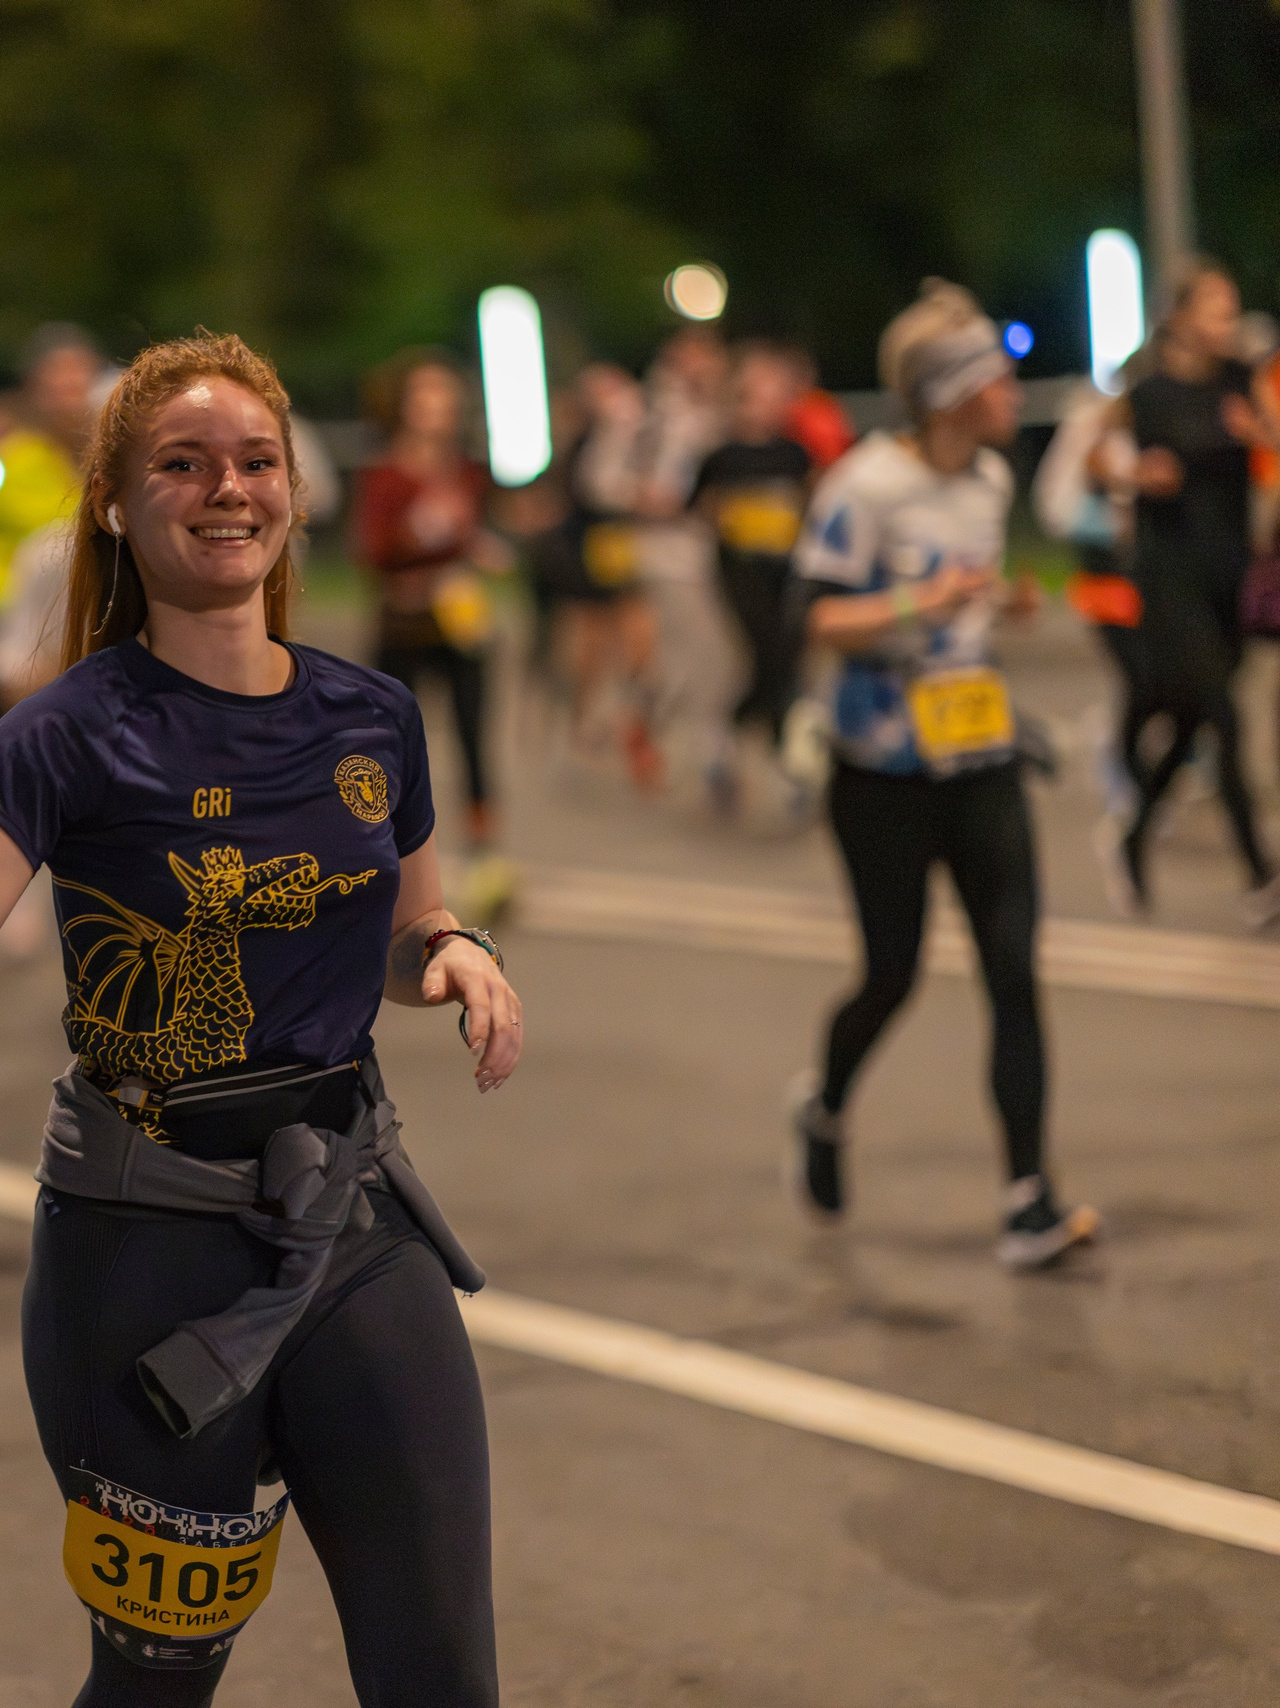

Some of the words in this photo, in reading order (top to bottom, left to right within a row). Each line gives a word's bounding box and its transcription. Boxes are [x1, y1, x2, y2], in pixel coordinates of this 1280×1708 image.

[192, 787, 232, 819] GRi
[178, 1536, 252, 1549] ЗАБЕГ
[91, 1533, 262, 1609] 3105
[116, 1594, 230, 1626] КРИСТИНА
